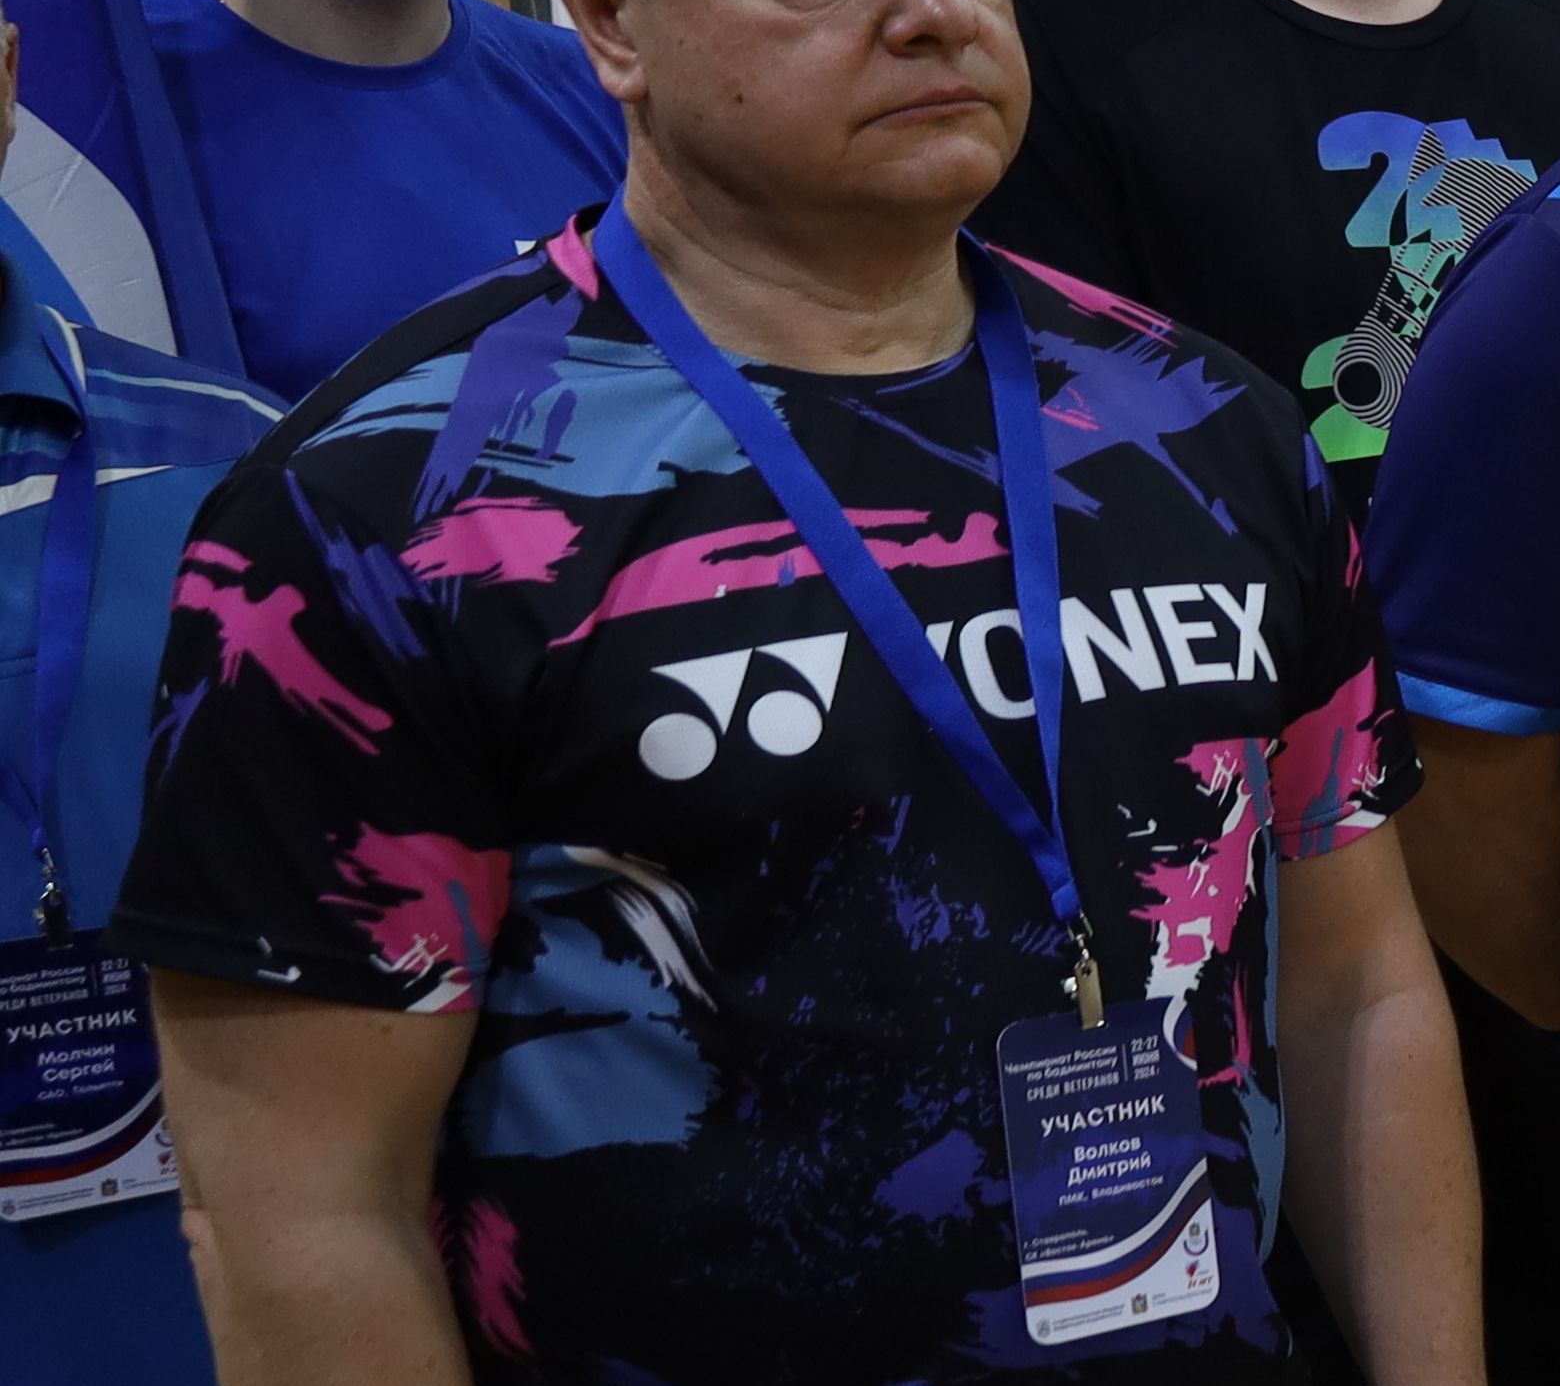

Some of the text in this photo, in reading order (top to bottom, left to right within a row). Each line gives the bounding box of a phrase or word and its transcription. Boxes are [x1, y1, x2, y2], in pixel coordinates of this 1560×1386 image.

[0, 997, 27, 1011] РЕДИ
[7, 1008, 137, 1044] УЧАСТНИК
[42, 1059, 115, 1083] Сергей
[1004, 1045, 1118, 1074] Чемпионат России
[1026, 1056, 1119, 1082] по бадминтону
[1026, 1072, 1120, 1103] СРЕДИ ВЕТЕРАНОВ
[1040, 1093, 1167, 1138] УЧАСТНИК
[1073, 1136, 1142, 1164] Волков
[1067, 1151, 1152, 1187] Дмитрий
[1091, 1175, 1165, 1200] Владивосток
